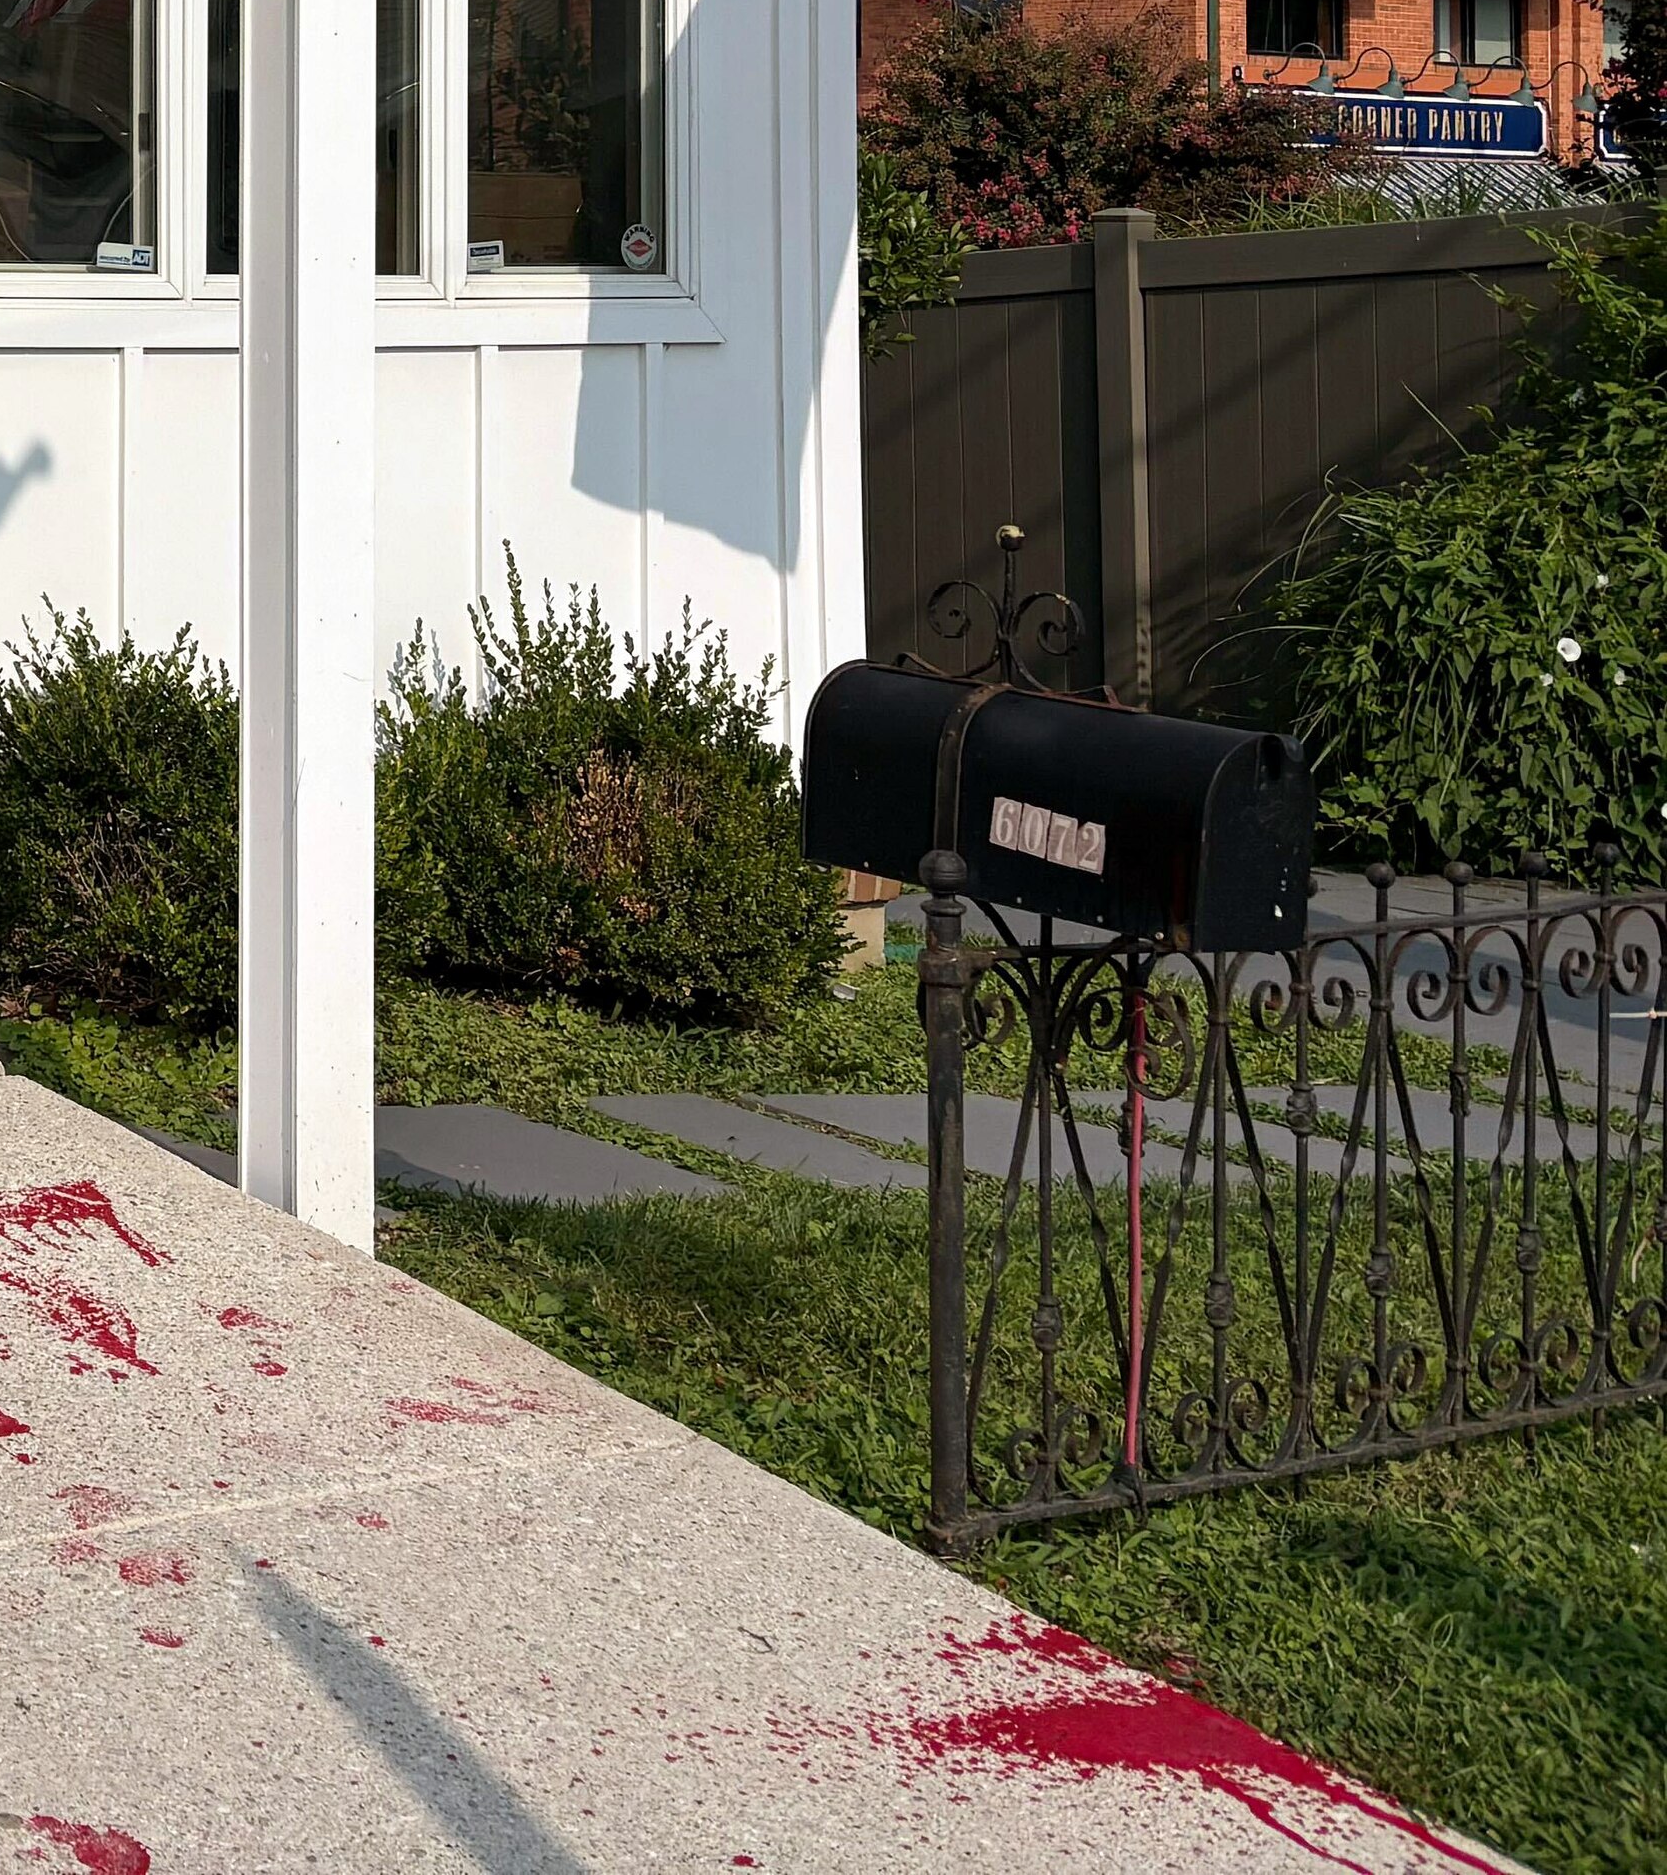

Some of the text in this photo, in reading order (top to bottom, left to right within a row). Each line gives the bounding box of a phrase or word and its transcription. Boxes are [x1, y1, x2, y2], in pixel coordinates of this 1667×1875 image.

[1338, 104, 1504, 143] CORNER PANTRY
[133, 251, 151, 265] ADT
[995, 802, 1100, 870] 6072
